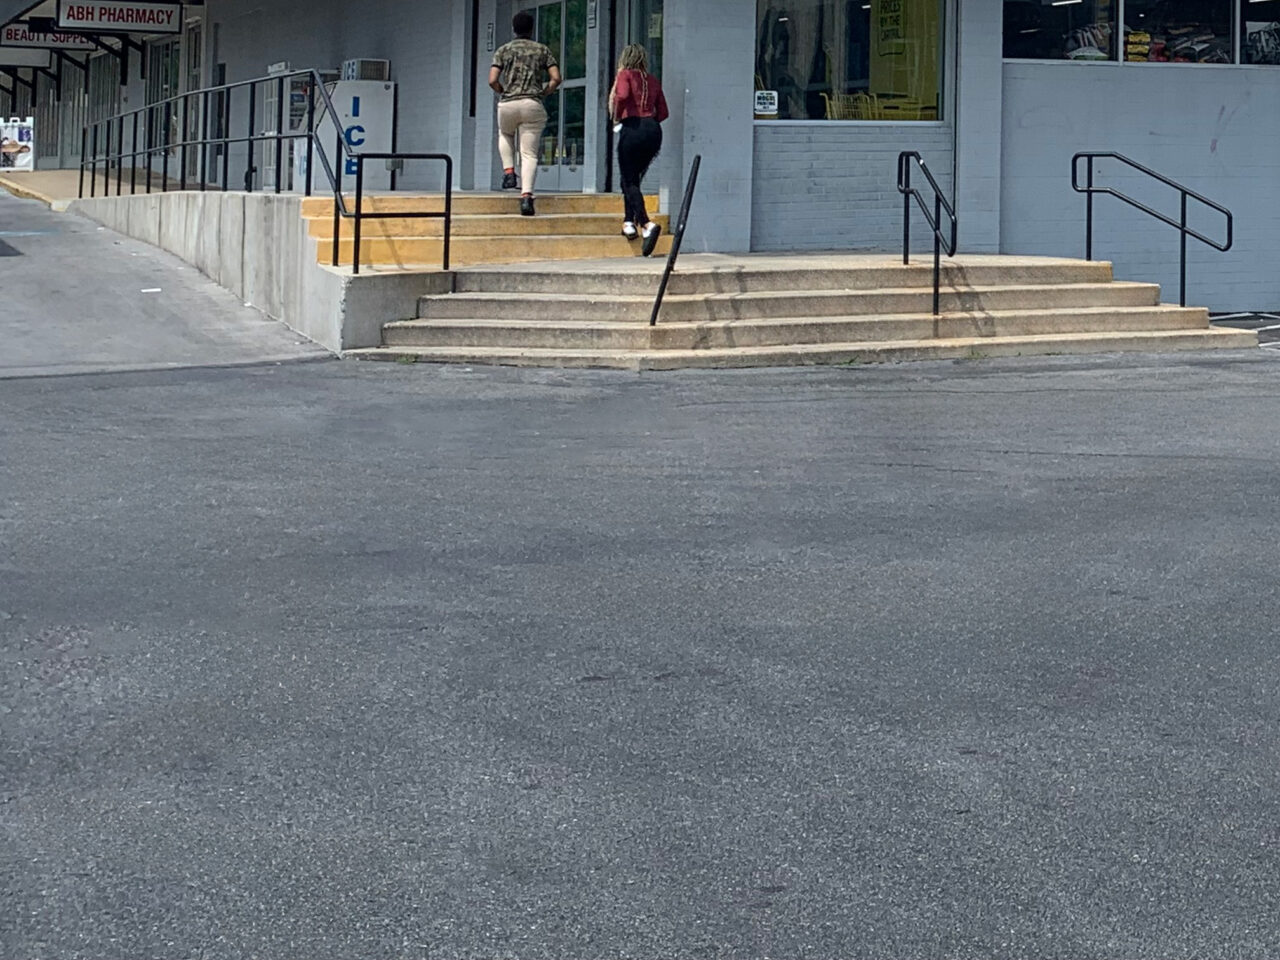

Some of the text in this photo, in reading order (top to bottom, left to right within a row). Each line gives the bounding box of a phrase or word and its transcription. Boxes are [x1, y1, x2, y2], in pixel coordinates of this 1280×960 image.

[67, 5, 174, 25] ABH PHARMACY
[6, 28, 91, 43] BEAUTY SUPPL
[345, 96, 365, 175] ICE
